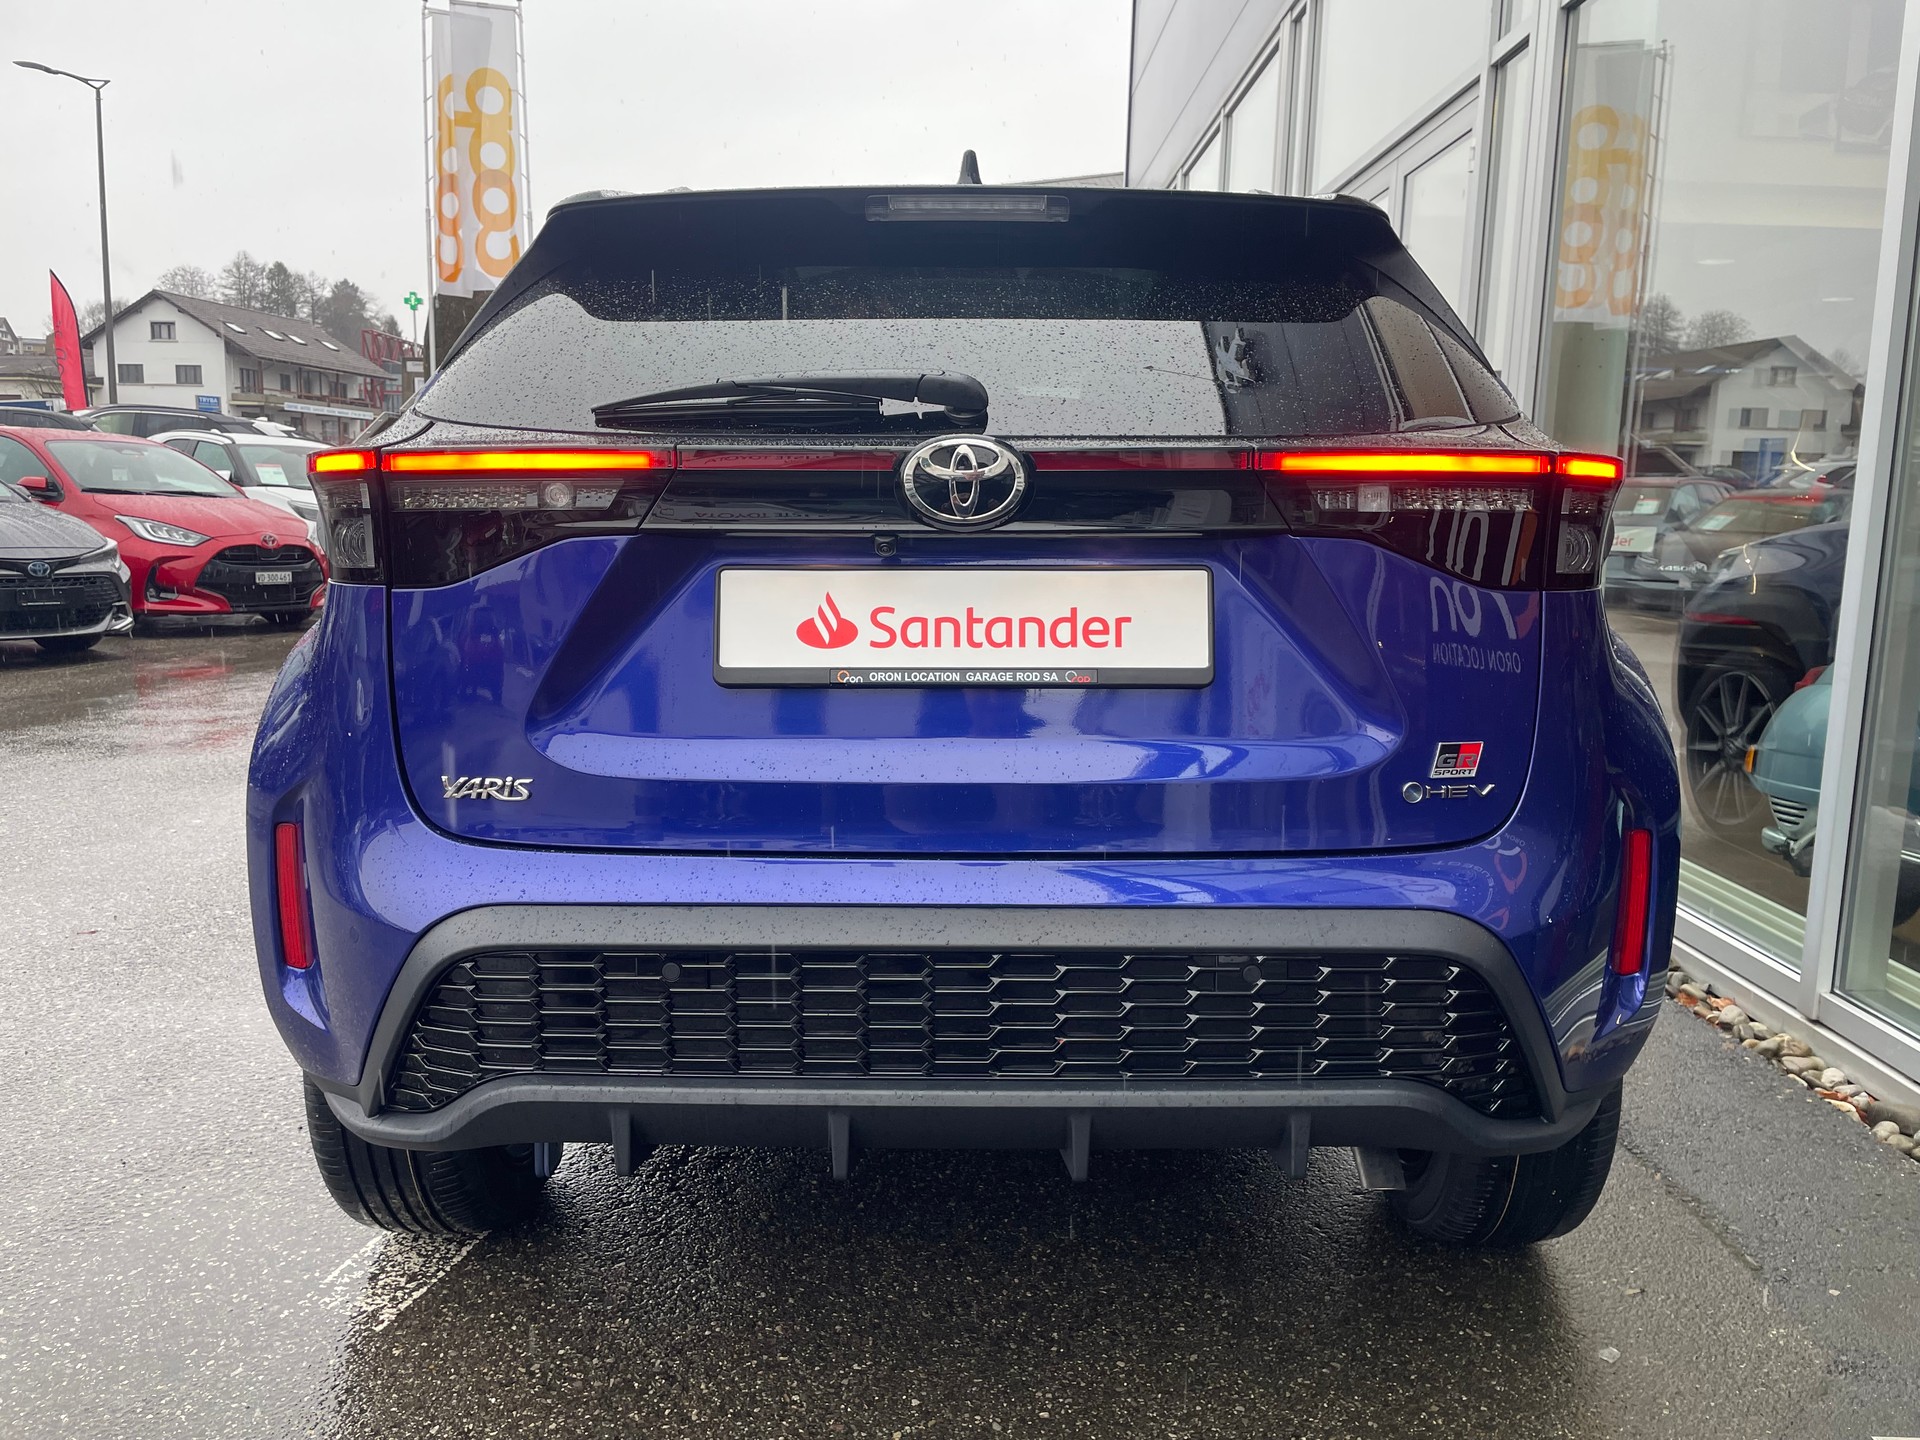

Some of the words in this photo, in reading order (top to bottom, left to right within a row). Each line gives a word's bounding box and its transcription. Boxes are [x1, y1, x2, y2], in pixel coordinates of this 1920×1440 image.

[869, 606, 1132, 649] Santander
[869, 672, 902, 682] ORON
[904, 672, 960, 682] LOCATION
[965, 672, 1014, 682] GARAGE
[1016, 672, 1040, 682] ROD
[1042, 672, 1059, 682] SA
[1437, 753, 1477, 768] GR
[1433, 768, 1475, 776] SPORT
